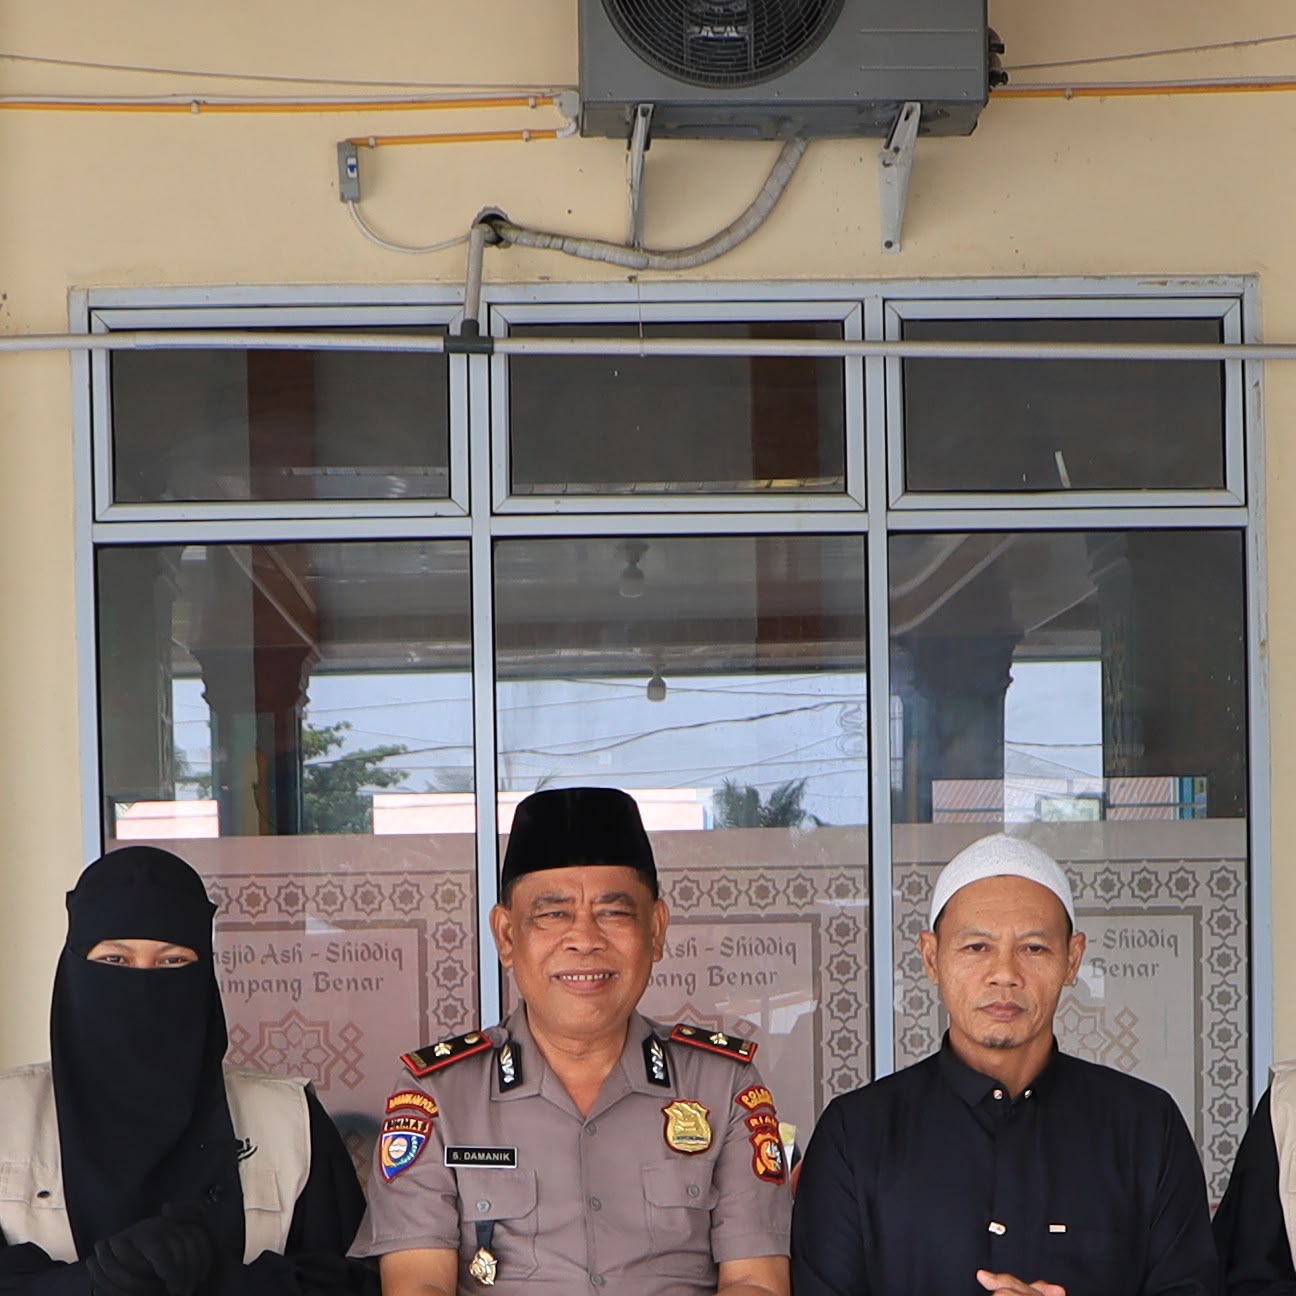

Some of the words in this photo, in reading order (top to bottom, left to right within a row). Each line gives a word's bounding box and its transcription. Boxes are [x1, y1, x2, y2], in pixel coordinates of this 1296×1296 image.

[719, 936, 797, 965] Shiddiq
[1103, 928, 1178, 957] Shiddiq
[214, 943, 256, 974] sjid
[261, 943, 303, 965] Ash
[326, 941, 403, 971] Shiddiq
[1089, 957, 1160, 978] Benar
[220, 974, 303, 1003] impang
[312, 971, 384, 993] Benar
[707, 965, 778, 987] Benar
[464, 1152, 510, 1161] DAMANIK
